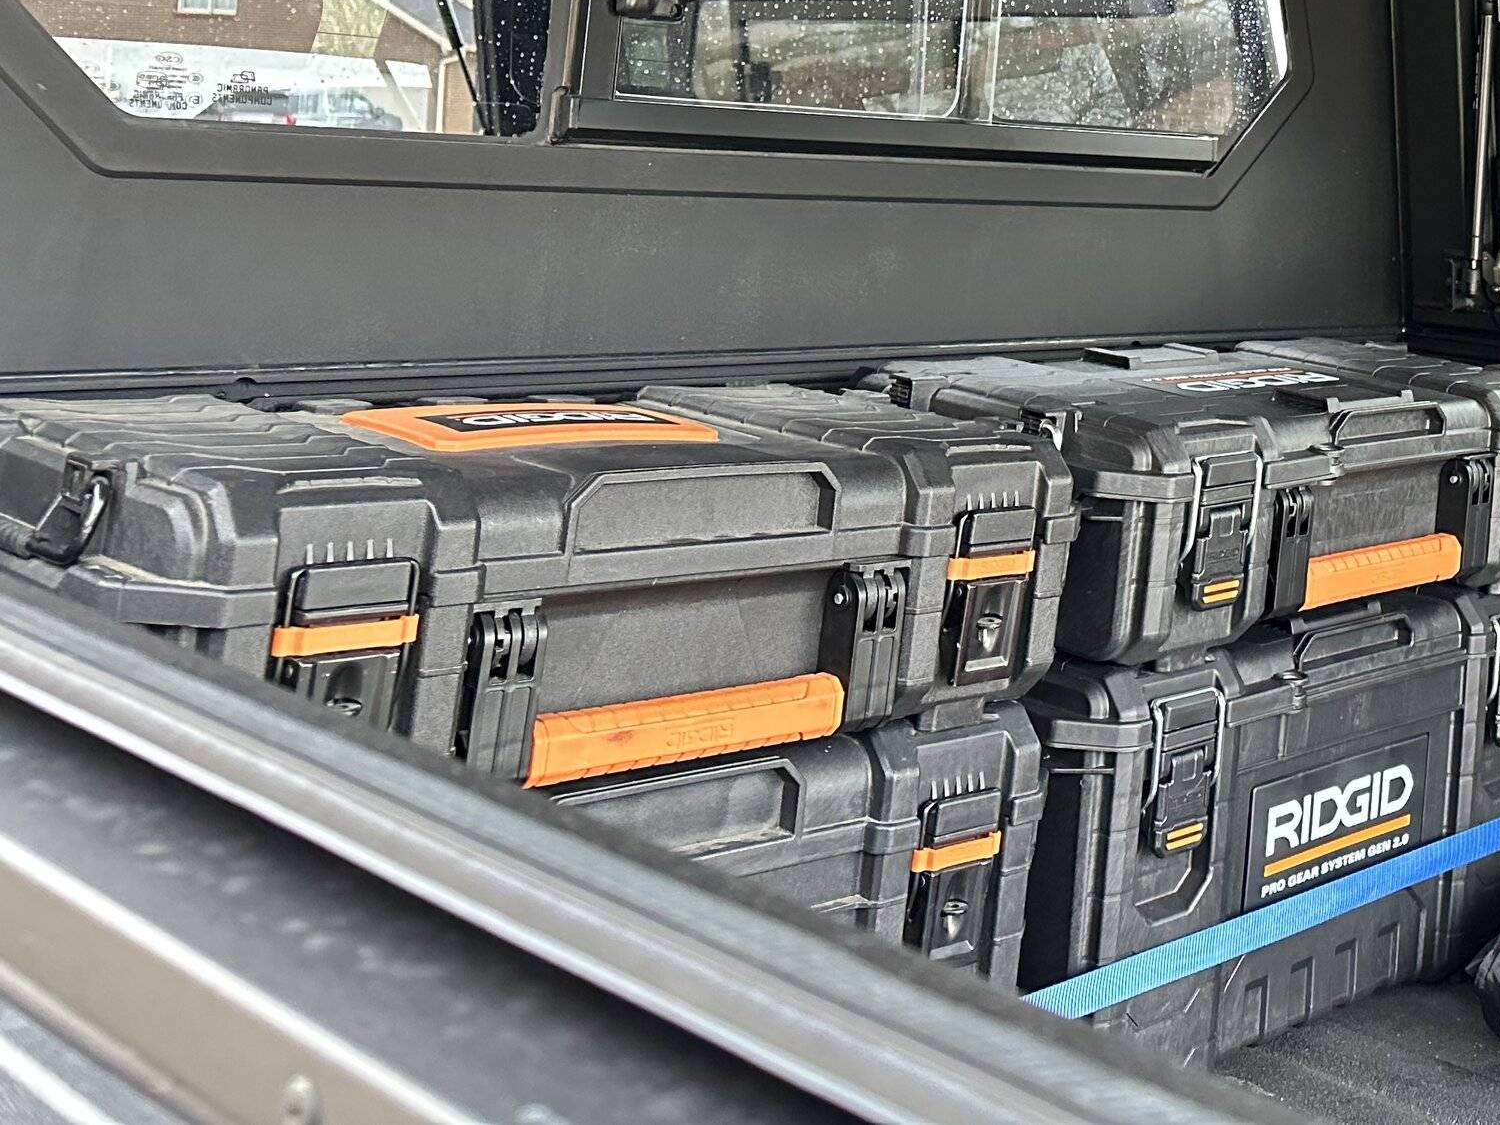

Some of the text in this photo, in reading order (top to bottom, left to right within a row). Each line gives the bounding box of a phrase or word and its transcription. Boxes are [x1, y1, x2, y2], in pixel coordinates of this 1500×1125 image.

[1176, 371, 1340, 392] RIDGID
[460, 411, 656, 427] RIDGID
[1265, 763, 1415, 858] RIDGID
[1260, 832, 1410, 899] PRO GEAR SYSTEM GEN 2.0
